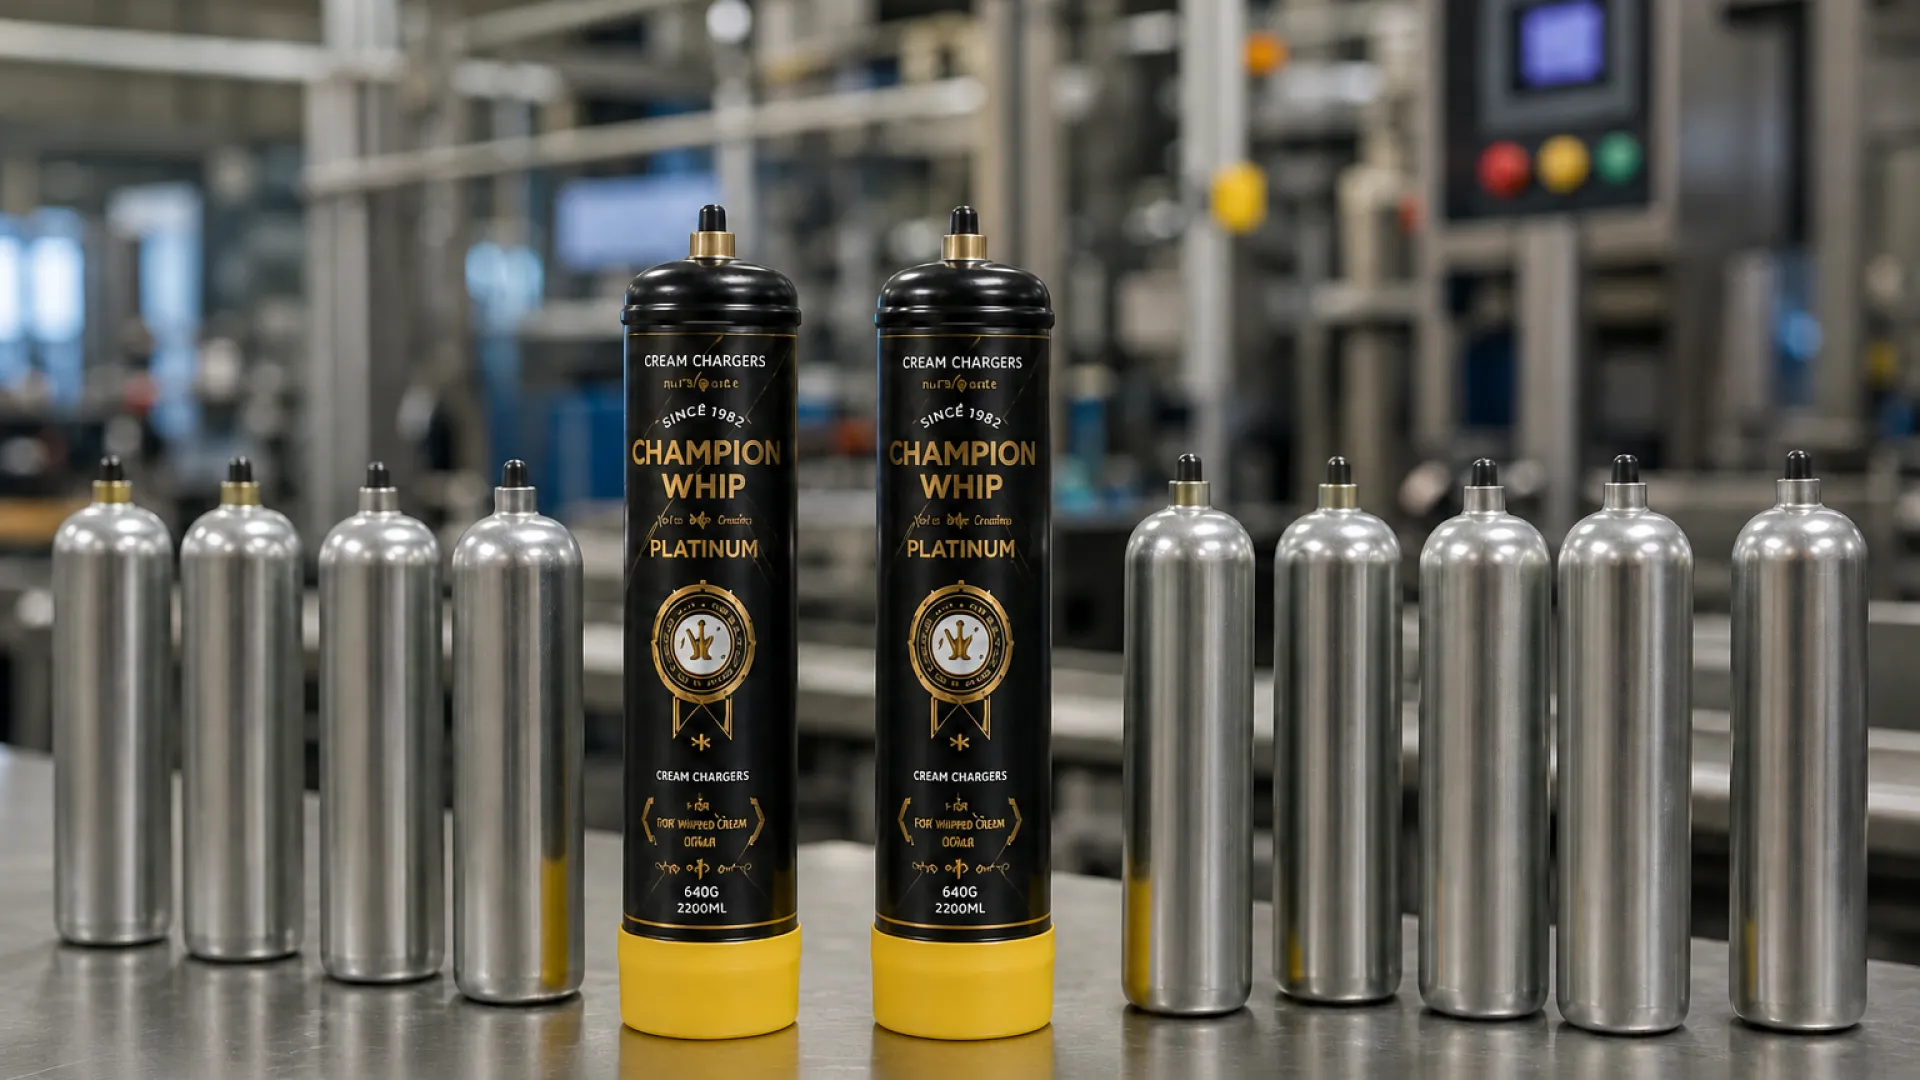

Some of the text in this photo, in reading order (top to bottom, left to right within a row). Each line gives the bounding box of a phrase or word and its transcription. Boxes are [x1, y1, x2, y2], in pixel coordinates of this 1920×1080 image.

[644, 354, 766, 367] CREAM CHARGERS
[902, 355, 1023, 369] CREAM CHARGERS
[711, 406, 745, 429] 1982
[969, 407, 1001, 430] 1982
[631, 439, 781, 466] CHAMPION
[889, 440, 1036, 466] CHAMPION
[660, 473, 746, 500] WHIP
[919, 474, 1004, 500] WHIP
[650, 539, 758, 559] PLATINUM
[907, 539, 1015, 559] PLATINUM
[655, 770, 750, 782] CREAM CHARGERS
[913, 770, 1008, 782] CREAM CHARGERS
[684, 886, 719, 898] 640G
[942, 886, 978, 898] 640G
[677, 902, 727, 914] 2200ML
[935, 902, 986, 914] 2200ML
